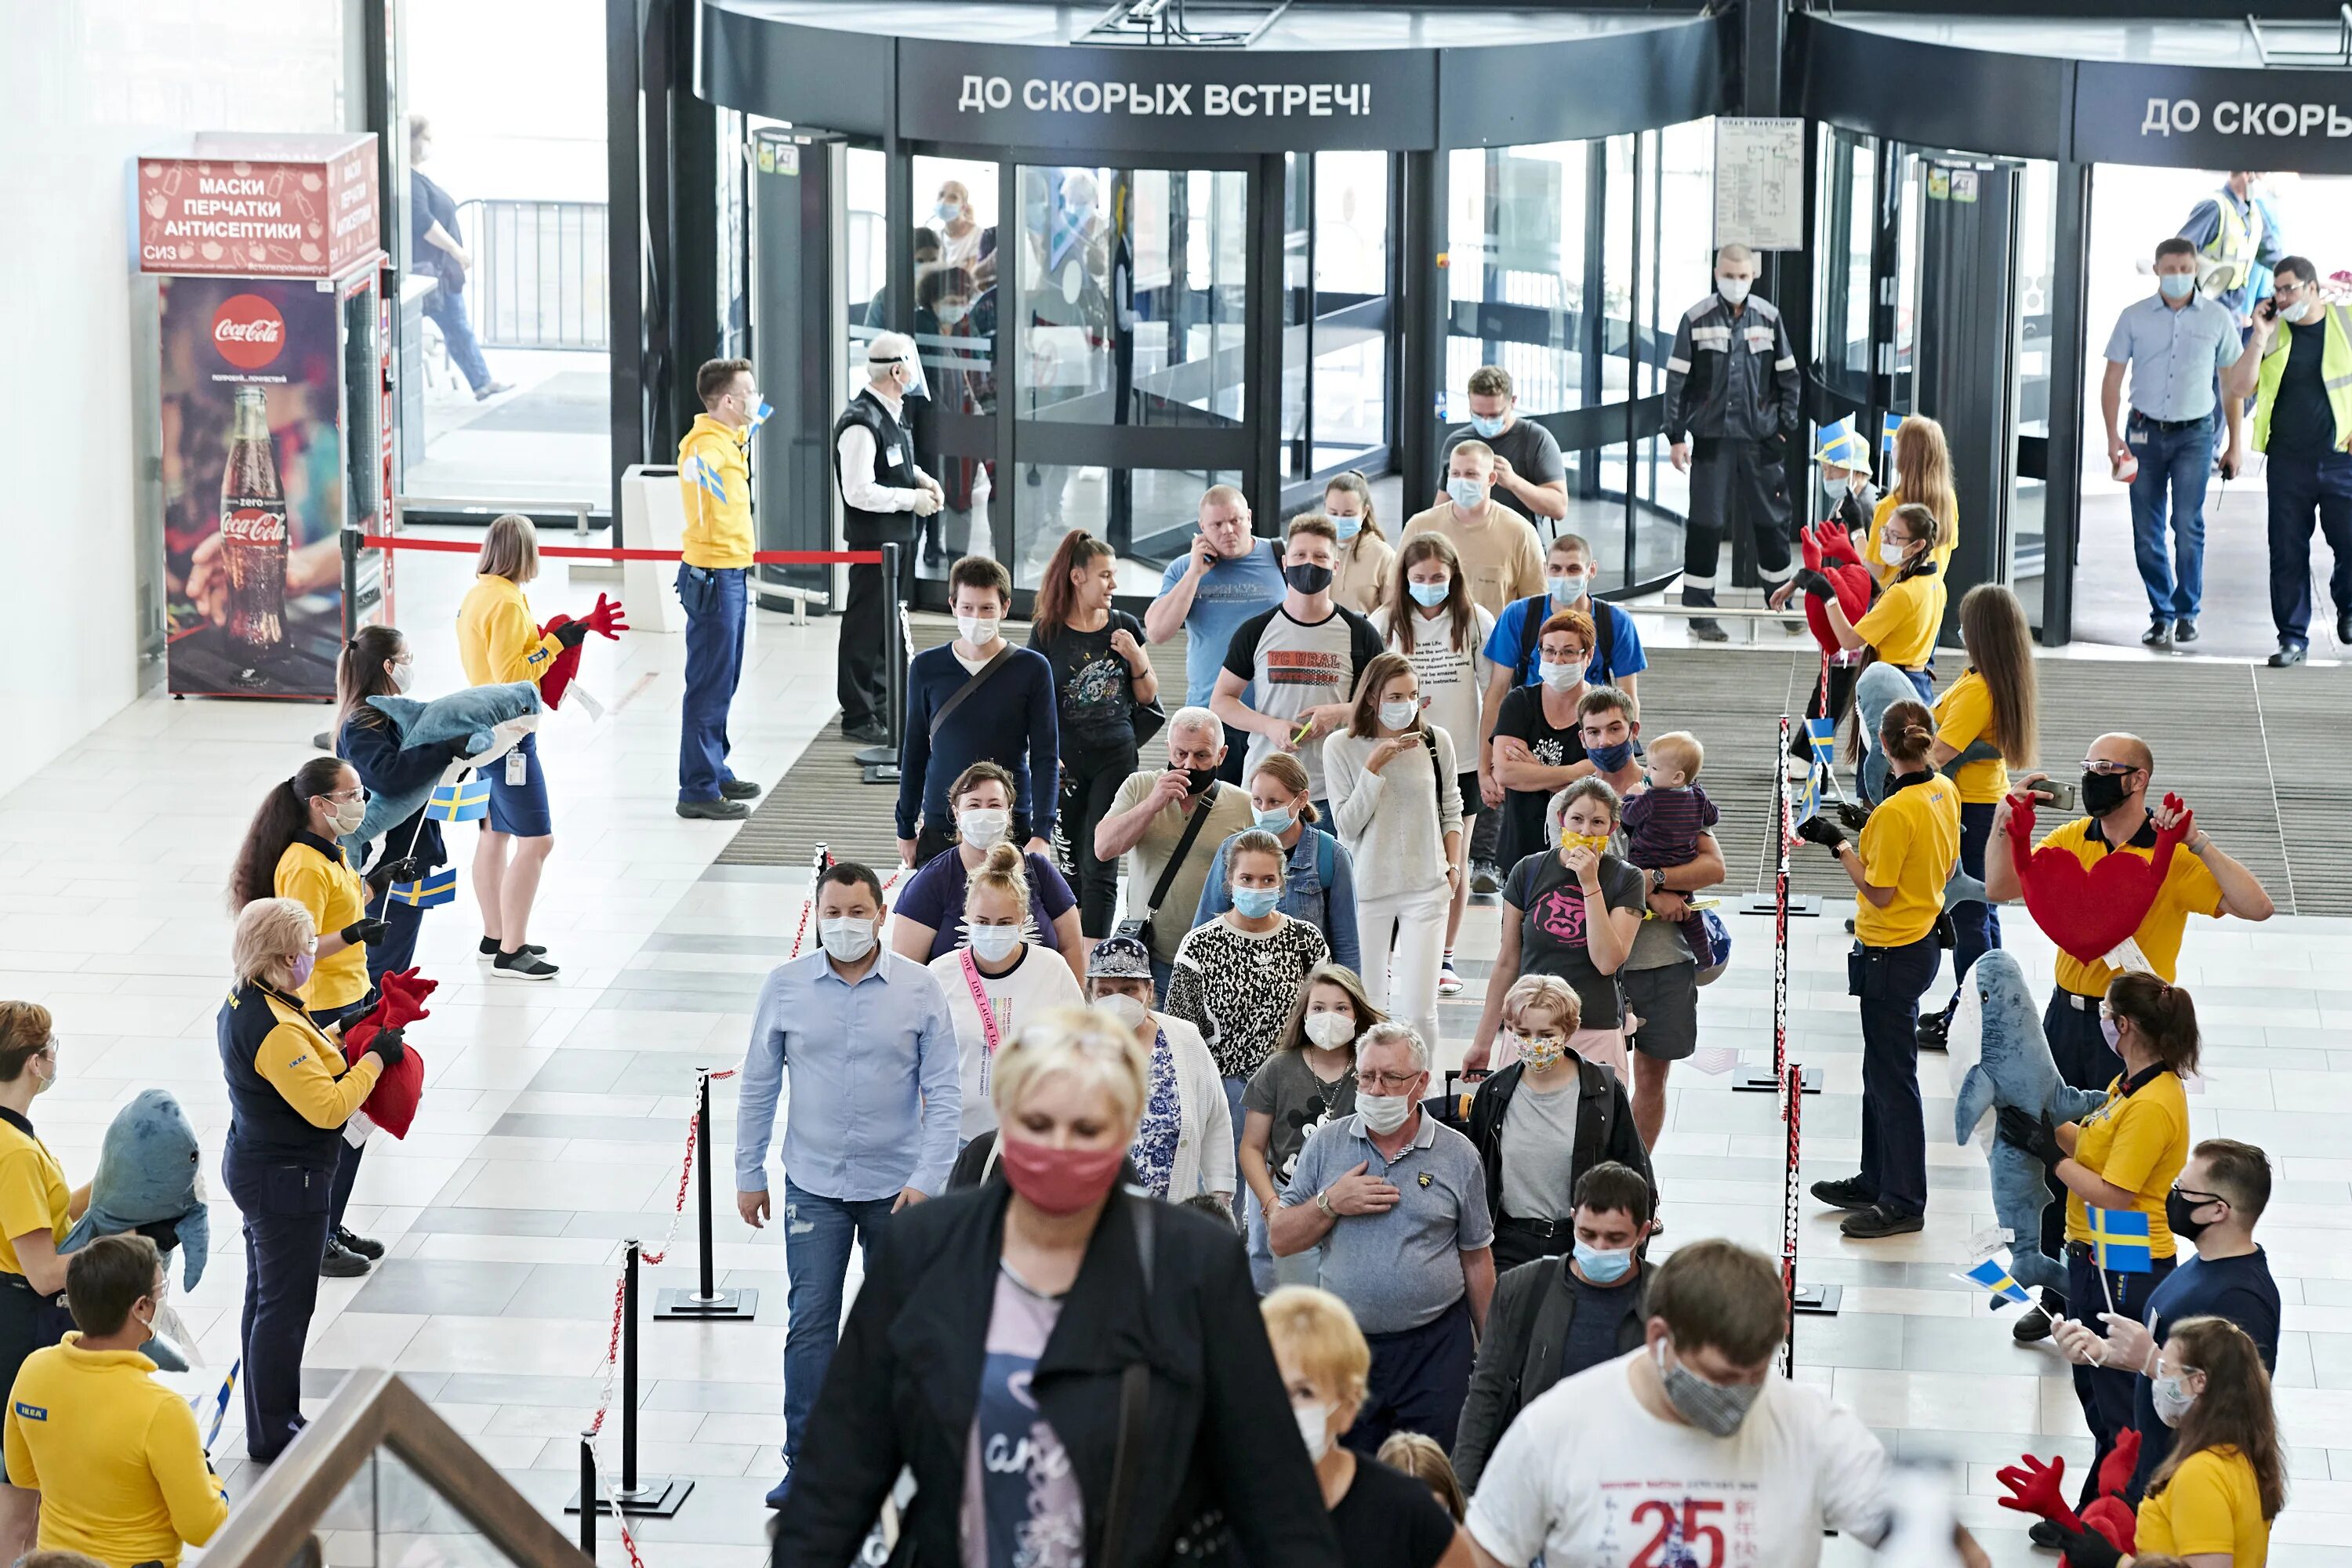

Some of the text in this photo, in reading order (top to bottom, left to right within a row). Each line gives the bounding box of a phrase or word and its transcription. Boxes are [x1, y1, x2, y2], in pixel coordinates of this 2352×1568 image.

[958, 76, 1371, 117] ДО СКОРЫХ ВСТРЕЧ!
[2141, 98, 2201, 137] ДО
[199, 178, 265, 196] МАСКИ
[183, 199, 282, 218] ПЕРЧАТКИ
[164, 220, 303, 239] АНТИСЕПТИКИ
[143, 245, 177, 262] СИЗ
[215, 318, 281, 343] Coca-Cola
[239, 498, 264, 508] zero
[220, 510, 287, 541] Coca-Cola
[1270, 652, 1340, 669] FC URAL
[962, 952, 973, 972] LOVE
[971, 980, 983, 1000] LIVE
[979, 1003, 994, 1030] LAUGH
[989, 1033, 998, 1047] LO
[289, 1054, 307, 1069] IKEA
[21, 1406, 42, 1418] IKEA
[1628, 1500, 1725, 1568] 25
